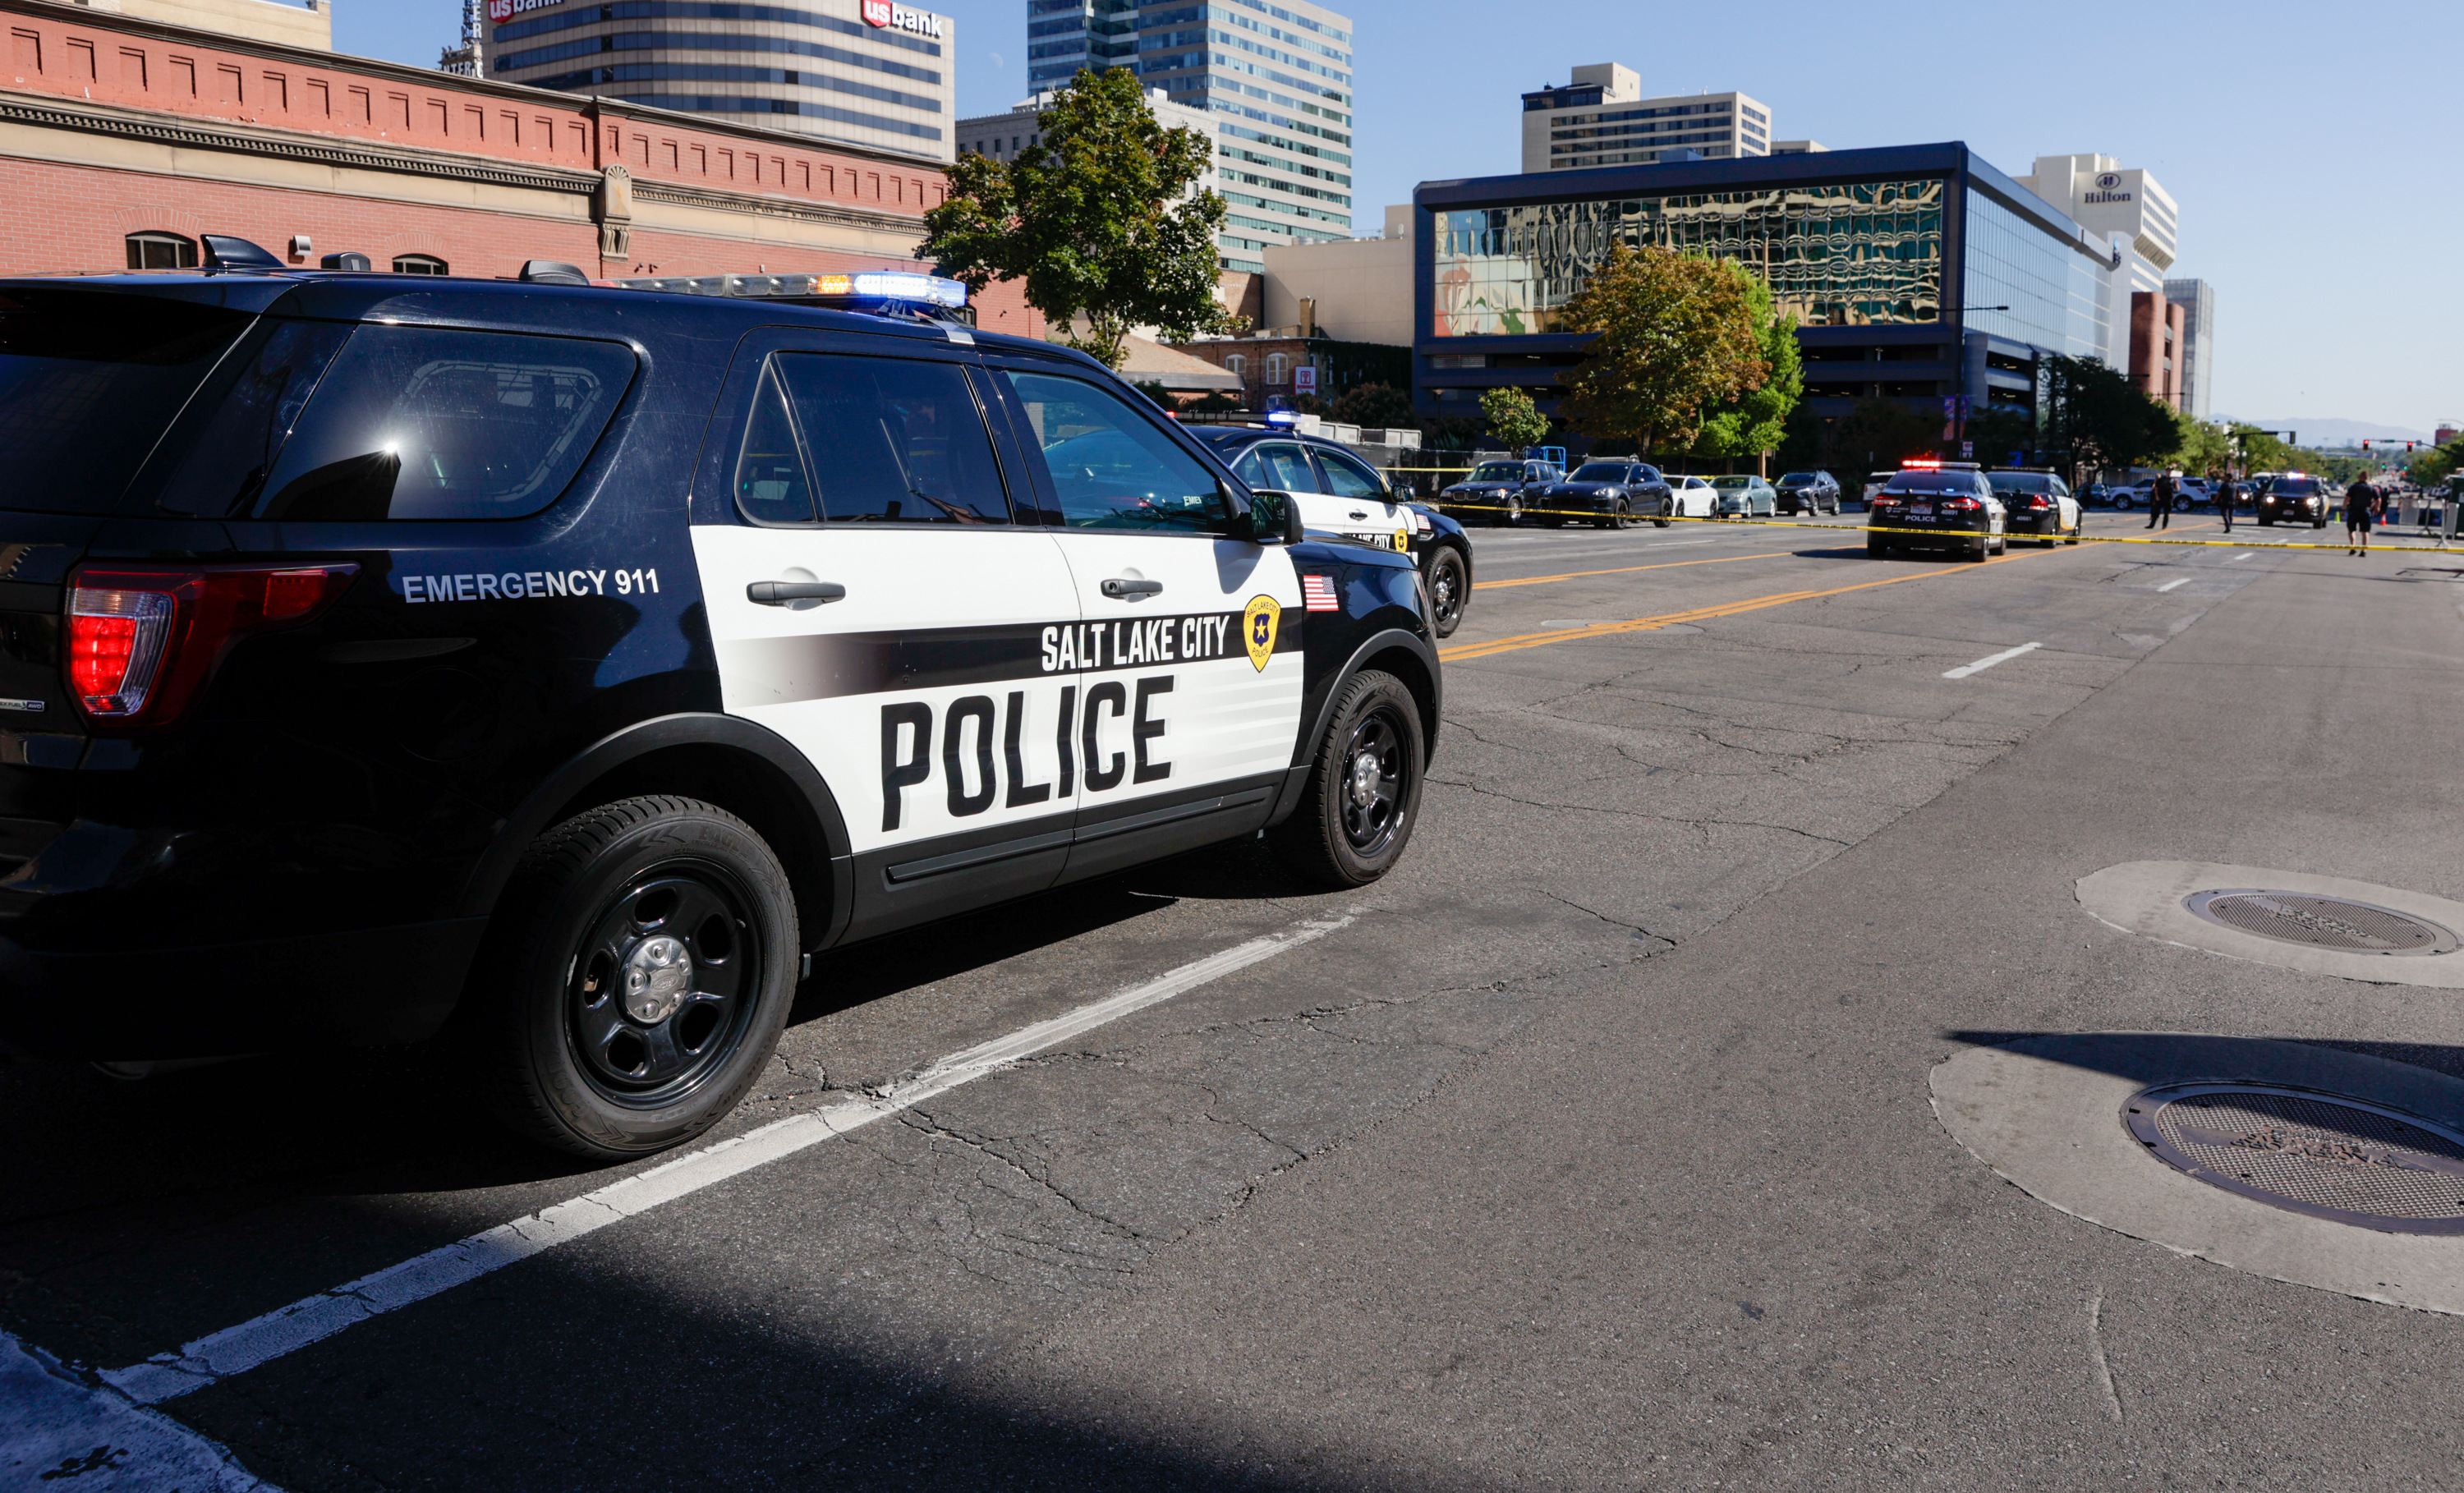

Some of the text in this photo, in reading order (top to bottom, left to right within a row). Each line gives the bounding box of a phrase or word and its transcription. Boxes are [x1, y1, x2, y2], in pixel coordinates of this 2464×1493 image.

[2085, 191, 2131, 203] Hilton
[402, 568, 659, 603] EMERGENCY 911
[1247, 601, 1279, 618] SALT LAKE CITY
[1042, 615, 1230, 671] SALT LAKE CITY
[1252, 646, 1268, 658] POLICE
[881, 675, 1175, 833] POLICE
